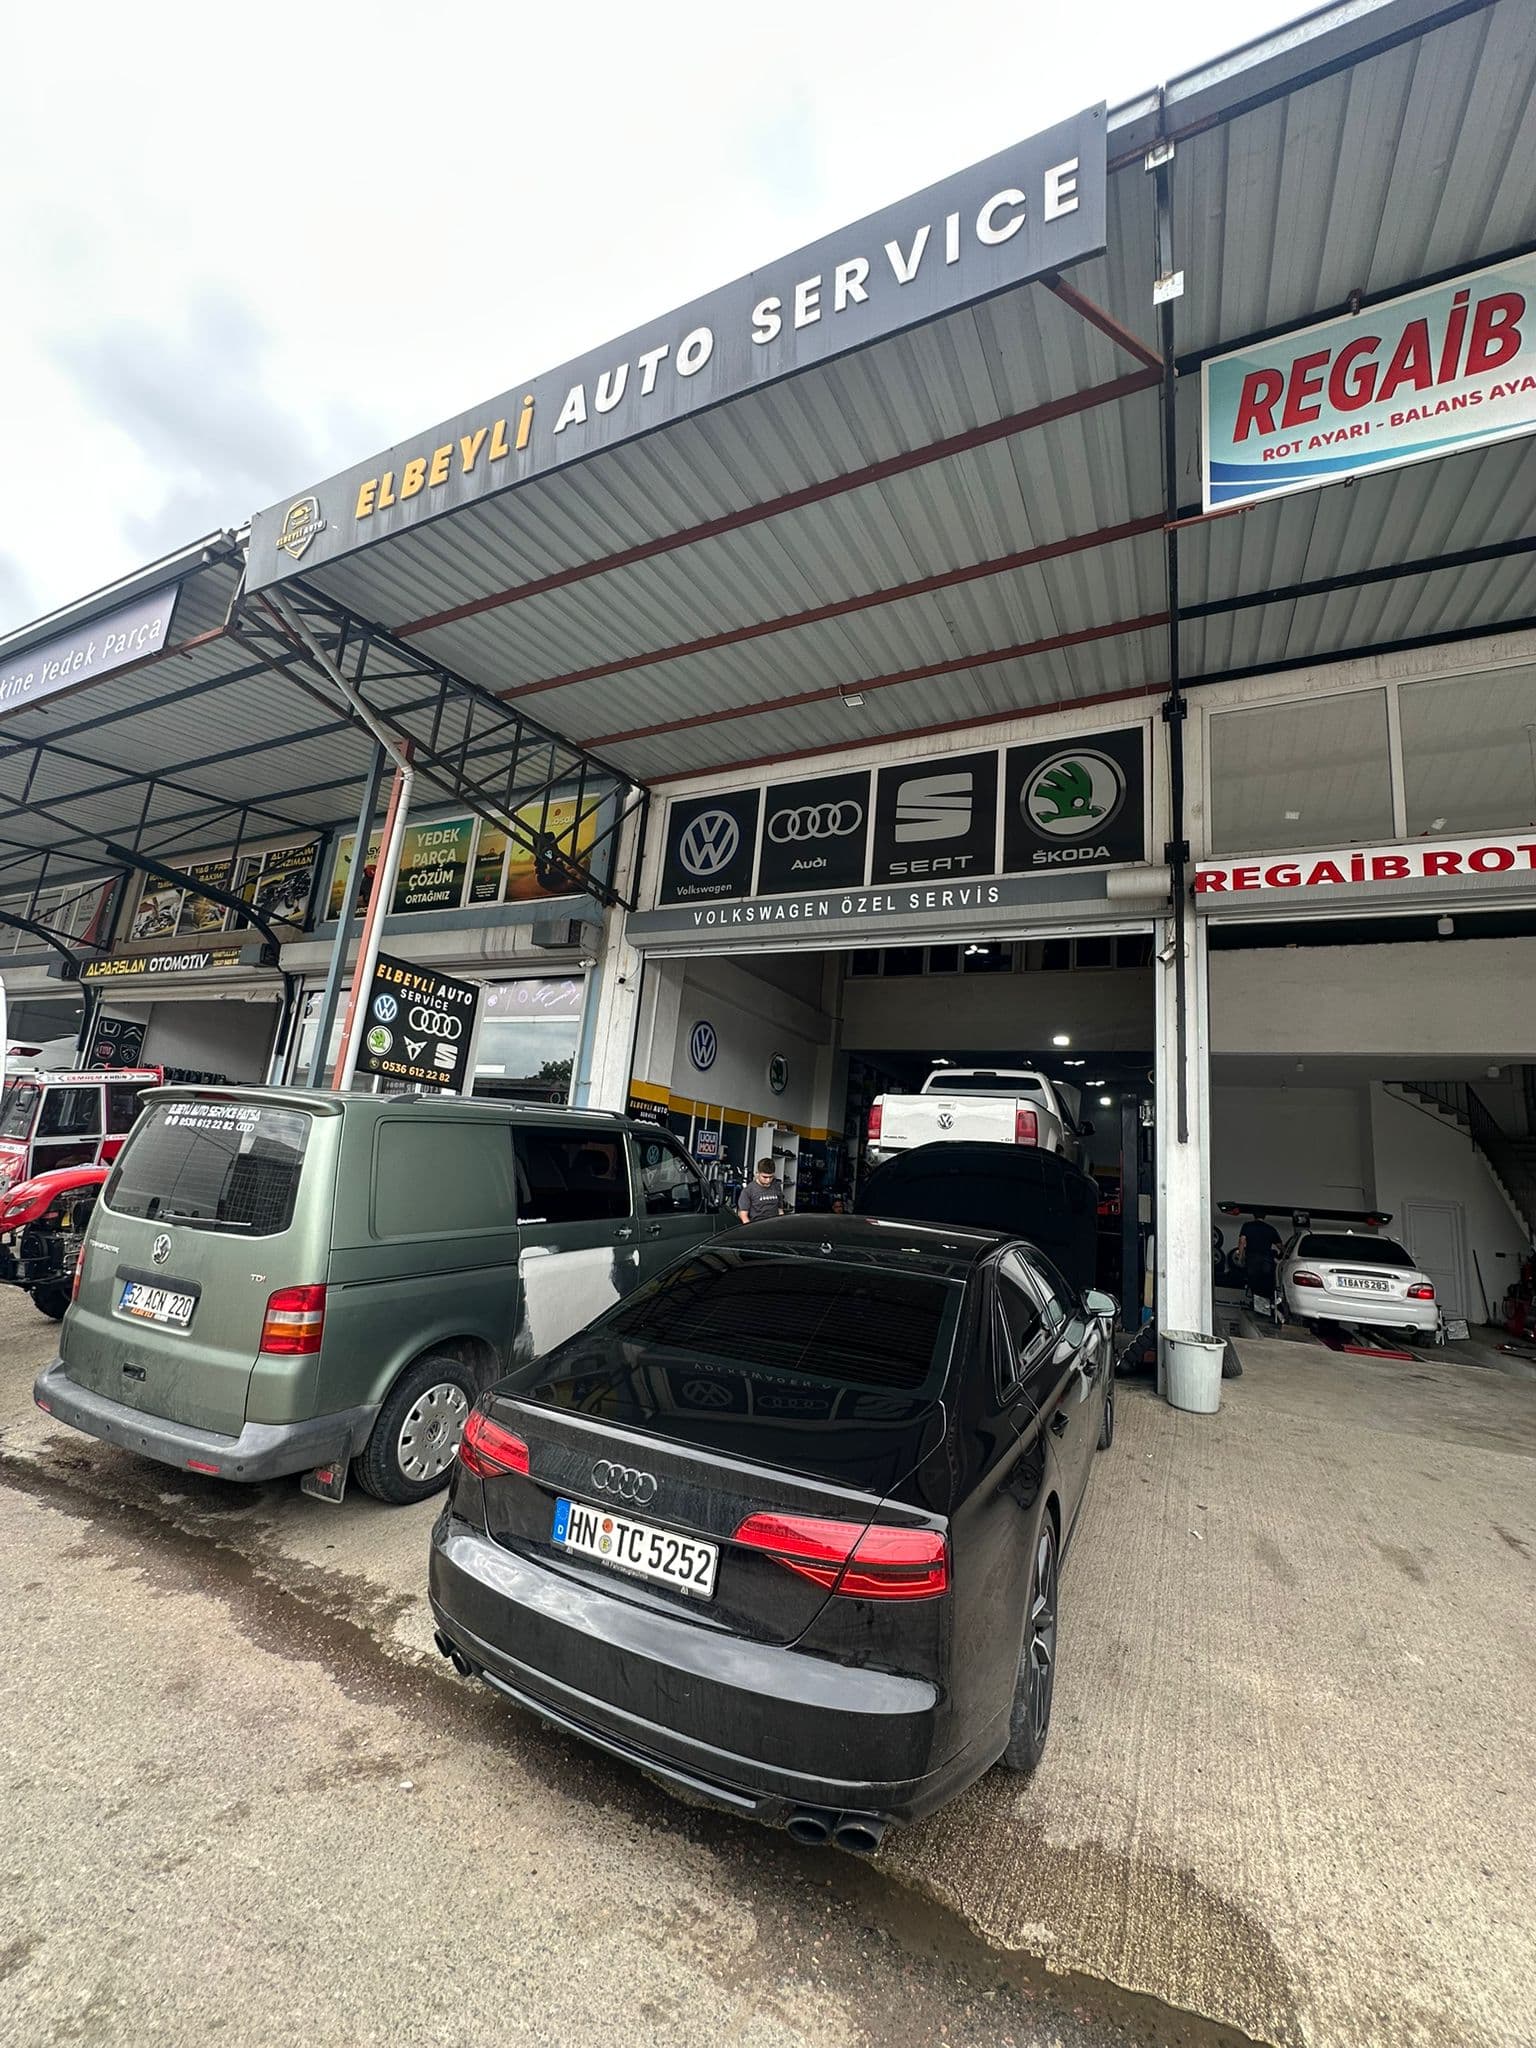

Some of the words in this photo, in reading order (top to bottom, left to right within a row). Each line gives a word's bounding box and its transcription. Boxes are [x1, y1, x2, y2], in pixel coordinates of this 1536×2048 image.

[354, 395, 536, 520] ELBEYLİ
[554, 326, 715, 434] AUTO
[750, 156, 1081, 346] SERVICE
[1233, 288, 1527, 444] REGAİB
[1262, 440, 1303, 461] ROT
[1309, 421, 1371, 450] AYARI
[1390, 390, 1483, 428] BALANS
[41, 642, 97, 685] Yedek
[102, 619, 162, 659] Parça
[417, 828, 460, 847] YEDEK
[412, 848, 457, 868] PARÇA
[791, 857, 827, 871] Audi
[889, 856, 974, 876] SEAT
[1032, 846, 1111, 865] ŠKODA
[408, 868, 454, 891] ÇÖZÜM
[1195, 853, 1411, 893] REGAİB
[405, 890, 450, 905] ORTAĞINIZ
[676, 882, 733, 896] Volkswagen
[694, 901, 829, 926] VOLKSWAGEN
[841, 895, 896, 914] ÖZEL
[909, 885, 999, 908] SERVİS
[86, 959, 147, 977] ALPARSLAN
[376, 963, 436, 994] ELBEYLİ
[437, 985, 473, 1006] AUTO
[400, 988, 449, 1012] SERVİCE
[382, 1060, 407, 1074] 0536
[408, 1066, 425, 1077] 612
[426, 1069, 437, 1080] 22
[438, 1073, 450, 1083] 82
[179, 1117, 197, 1127] 0536
[197, 1118, 211, 1129] 612
[211, 1120, 223, 1129] 22
[222, 1121, 234, 1131] 82
[127, 1286, 143, 1305] 52
[145, 1288, 167, 1311] ACN
[168, 1295, 192, 1318] 220
[557, 1525, 564, 1535] D
[568, 1508, 599, 1549] HN
[616, 1523, 645, 1563] TC
[648, 1533, 712, 1587] 5252
